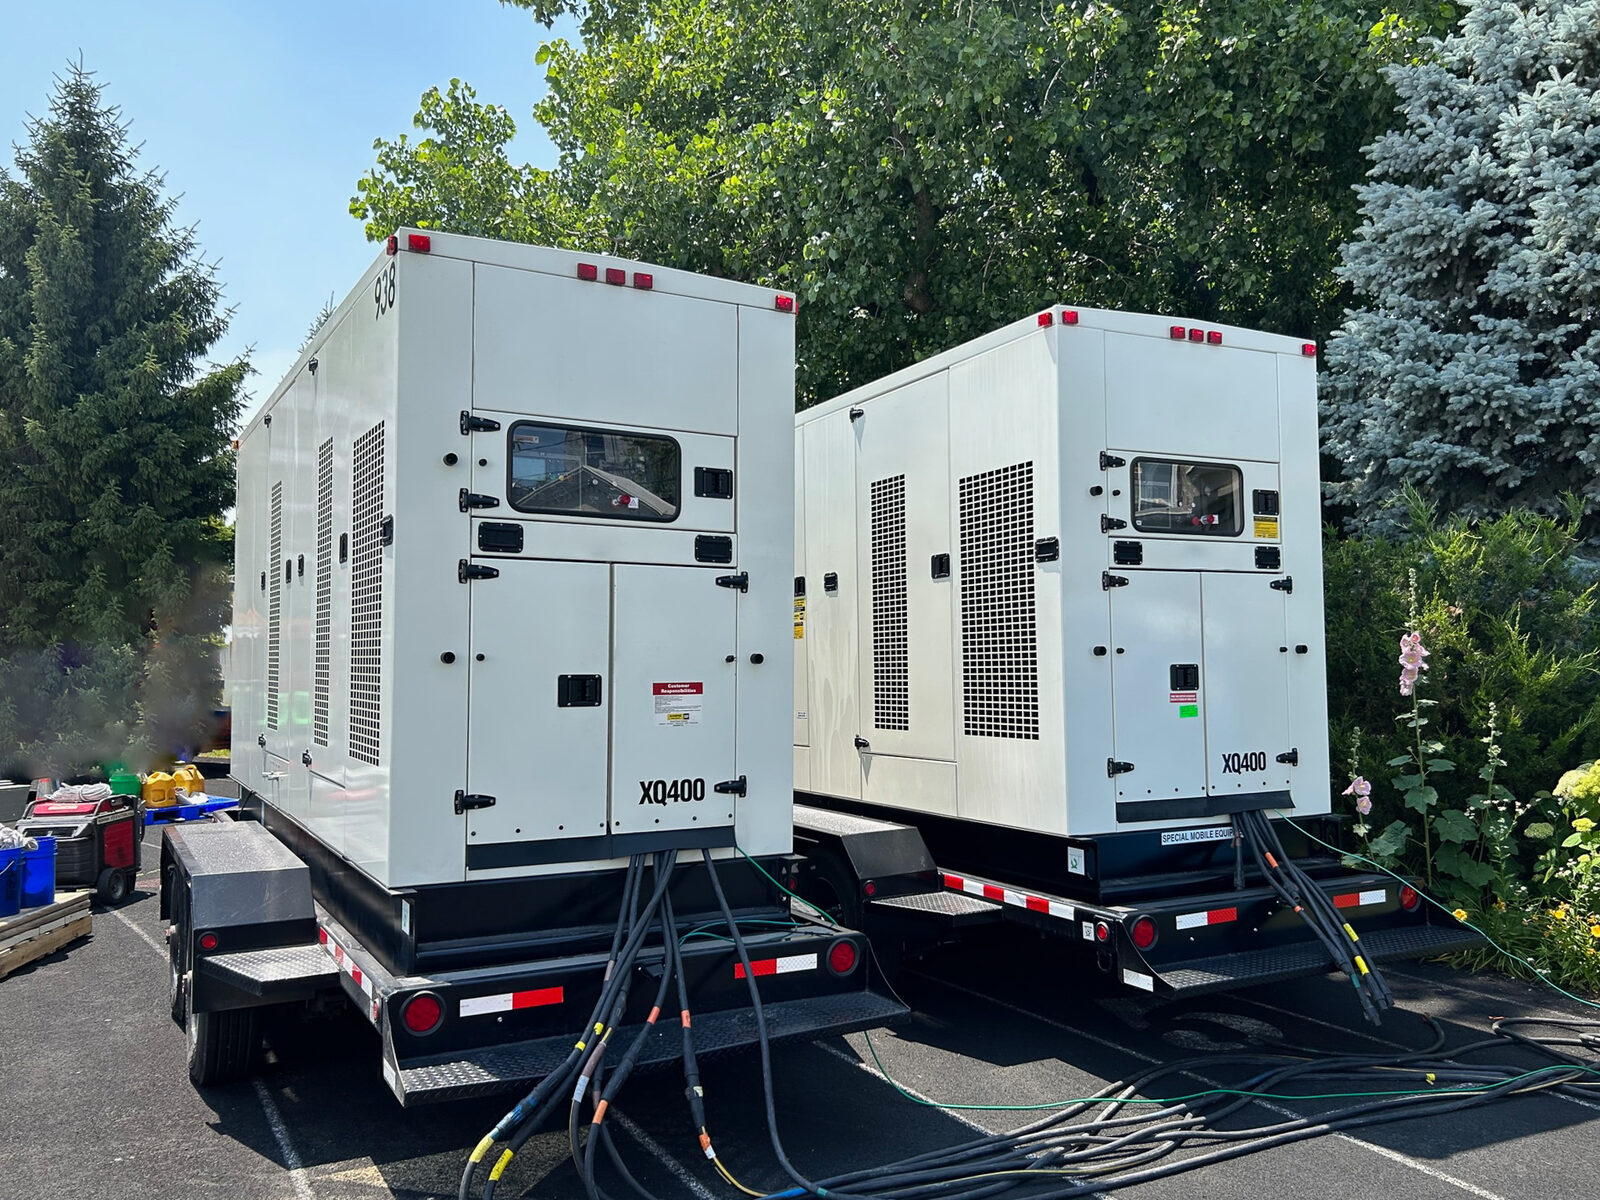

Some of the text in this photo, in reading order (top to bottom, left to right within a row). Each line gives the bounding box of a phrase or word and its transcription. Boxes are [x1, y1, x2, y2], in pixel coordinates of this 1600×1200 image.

[374, 261, 396, 321] 938
[1222, 751, 1267, 775] XQ400
[638, 777, 706, 806] XQ400
[1162, 832, 1189, 843] SPECIAL
[1190, 830, 1214, 840] MOBILE
